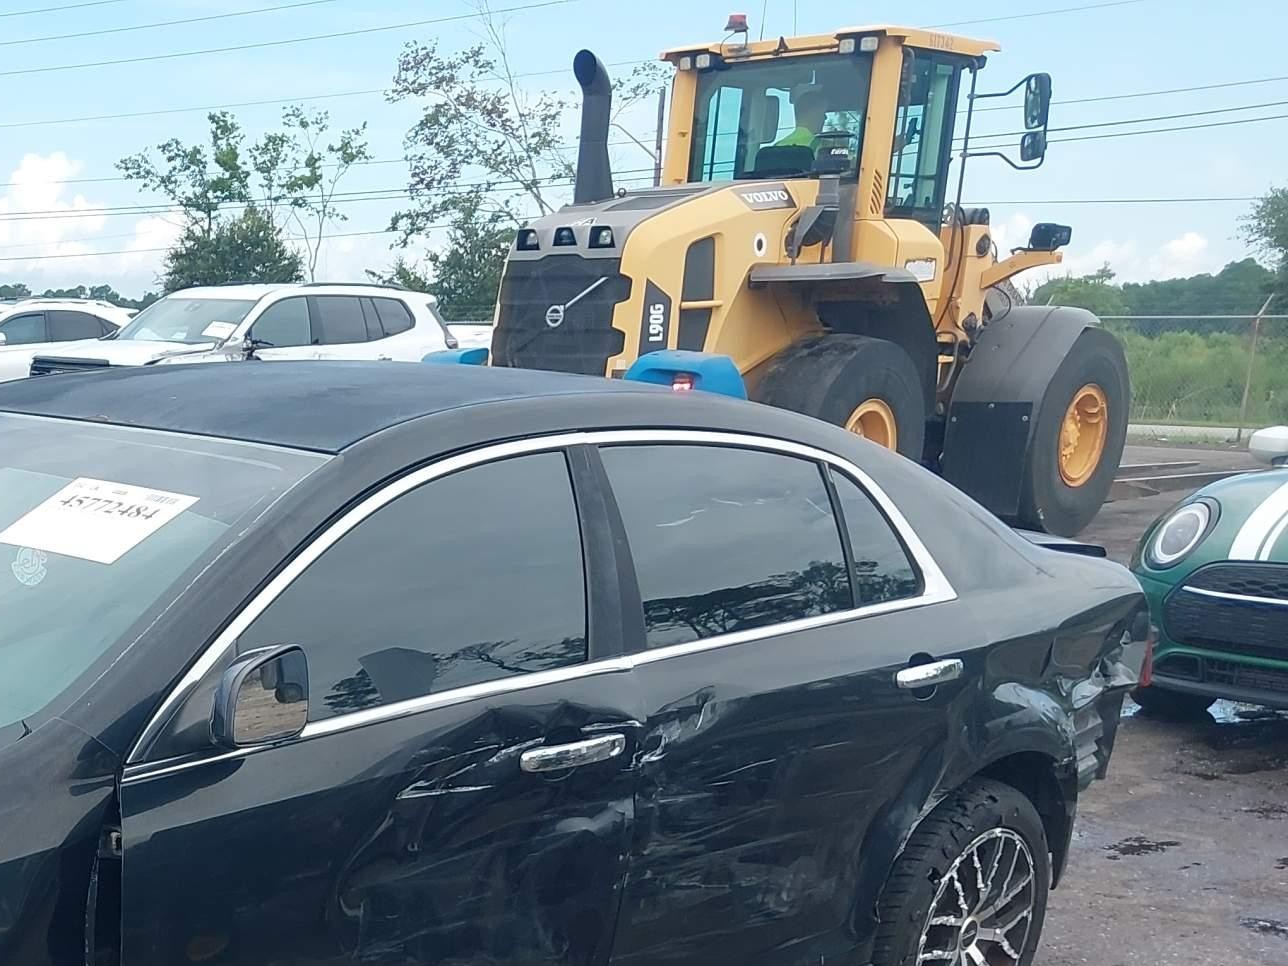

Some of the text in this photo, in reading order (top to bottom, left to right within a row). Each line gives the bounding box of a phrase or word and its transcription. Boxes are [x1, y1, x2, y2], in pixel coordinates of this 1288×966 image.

[741, 190, 789, 204] VOLVO
[648, 303, 665, 342] L90G
[59, 494, 161, 520] 45772484
